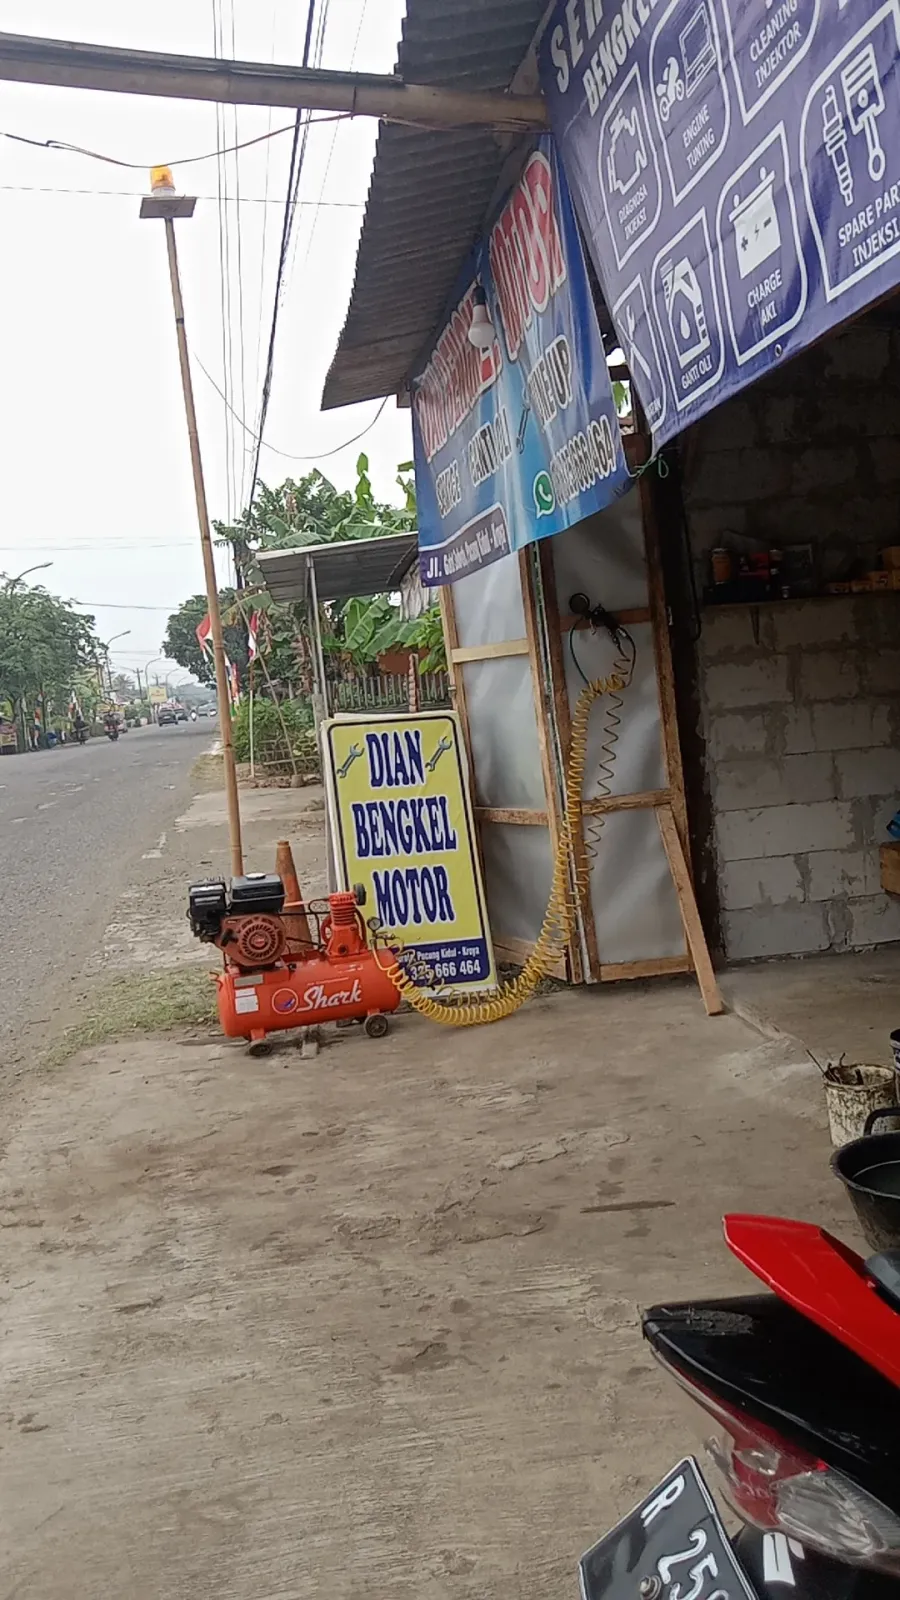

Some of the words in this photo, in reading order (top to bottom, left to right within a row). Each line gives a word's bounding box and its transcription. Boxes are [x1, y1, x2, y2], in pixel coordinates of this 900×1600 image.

[750, 0, 799, 62] CLEANING
[755, 21, 802, 88] INJEKTOR
[582, 0, 658, 118] BENGKE
[683, 104, 710, 148] ENGINE
[687, 127, 715, 170] TUNING
[838, 204, 874, 247] SPARE
[875, 180, 900, 219] PAR
[852, 217, 900, 267] INJEKSI
[747, 269, 783, 308] CHARGE
[761, 300, 778, 326] AKI
[681, 364, 700, 389] GANTI
[698, 354, 713, 375] OLI
[366, 730, 425, 787] DIAN
[352, 796, 457, 858] BENGKEL
[372, 865, 455, 928] MOTOR
[434, 961, 457, 979] 666
[459, 958, 482, 976] 464
[296, 979, 362, 1013] Shark
[639, 1474, 686, 1528] R
[656, 1528, 730, 1600] 25
